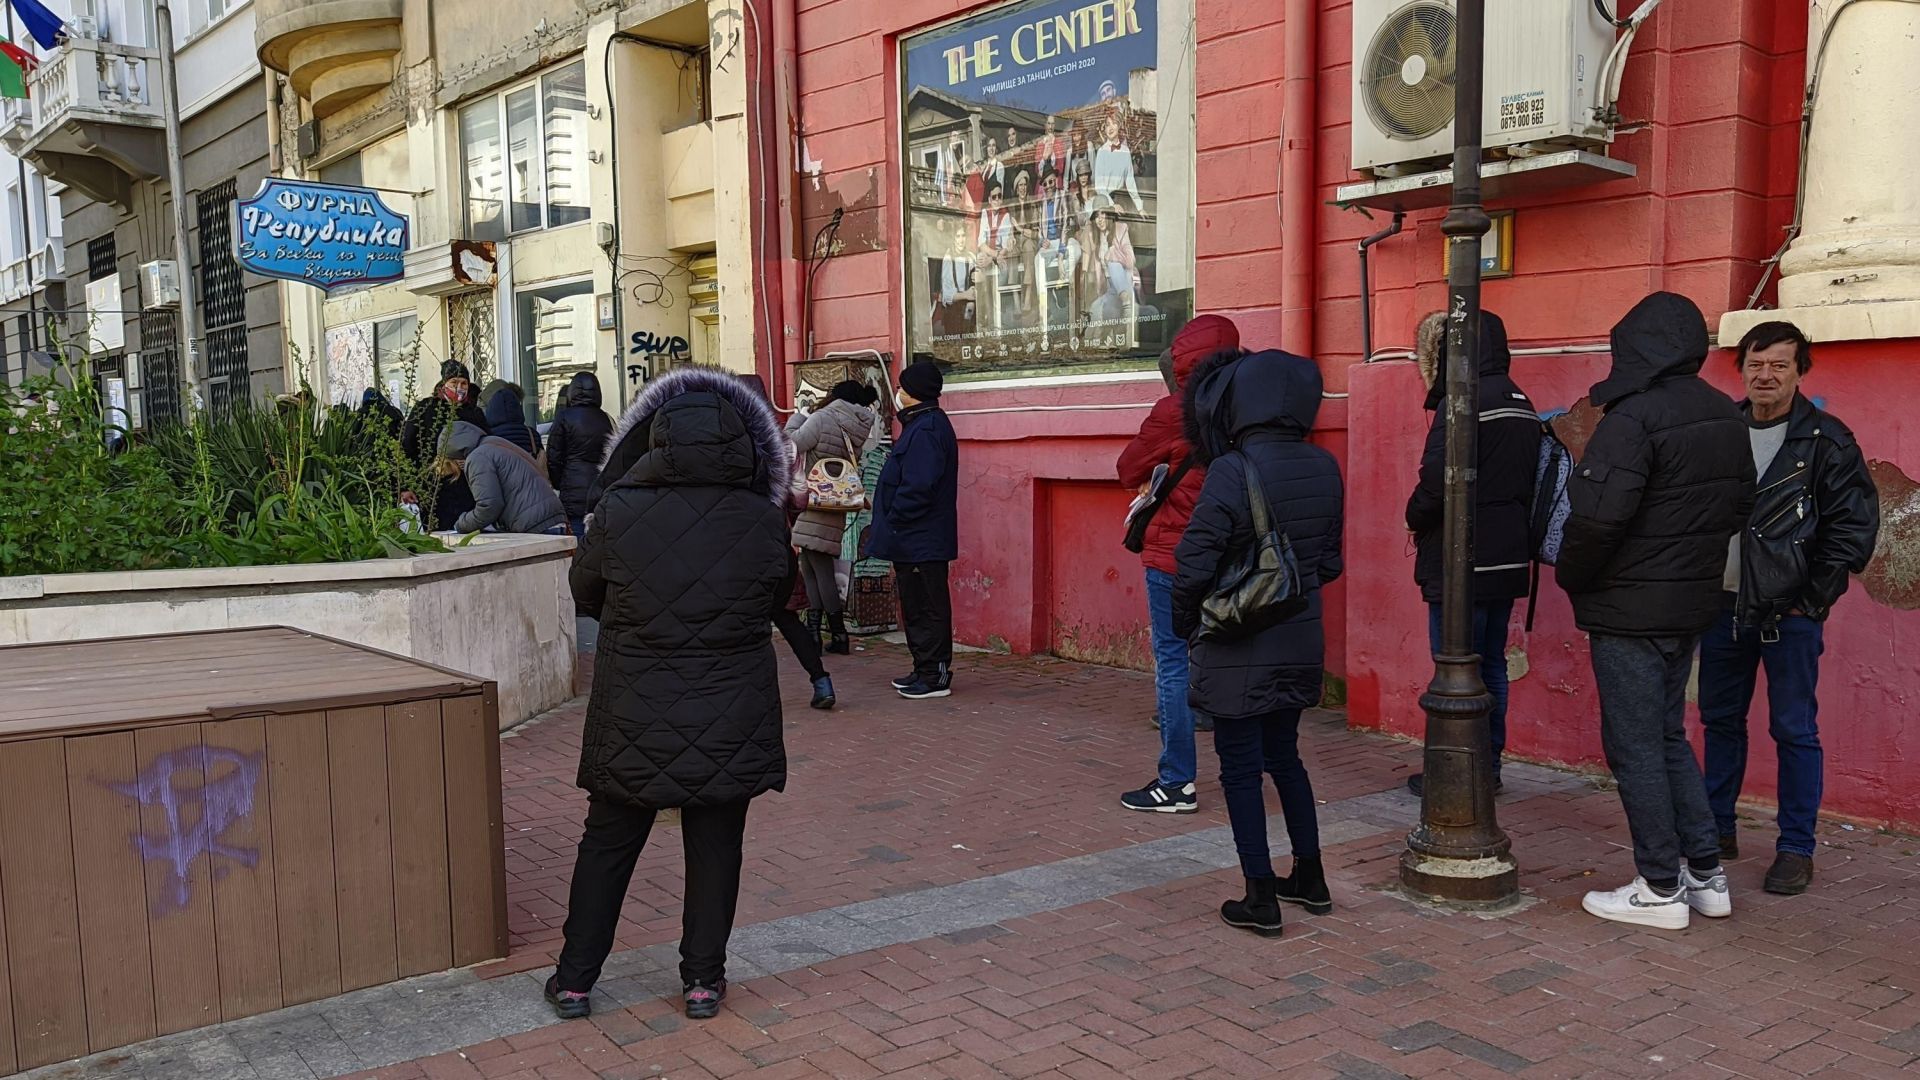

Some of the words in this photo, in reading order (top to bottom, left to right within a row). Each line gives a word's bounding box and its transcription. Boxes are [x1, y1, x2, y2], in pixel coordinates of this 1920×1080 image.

[943, 35, 1002, 85] THE
[1010, 0, 1142, 66] CENTER
[982, 78, 1017, 96] УЧИЛИЩЕ
[1017, 76, 1027, 86] ЗА
[1027, 68, 1053, 84] ТАНЦИ,
[1053, 61, 1078, 76] СЕЗОН
[1078, 57, 1096, 69] 2020
[1501, 103, 1514, 116] 052
[1530, 98, 1544, 112] 923
[1501, 116, 1517, 129] 0879
[1517, 113, 1530, 127] 000
[1531, 111, 1544, 125] 665
[276, 189, 376, 217] ФУРНА
[243, 206, 403, 247] Република
